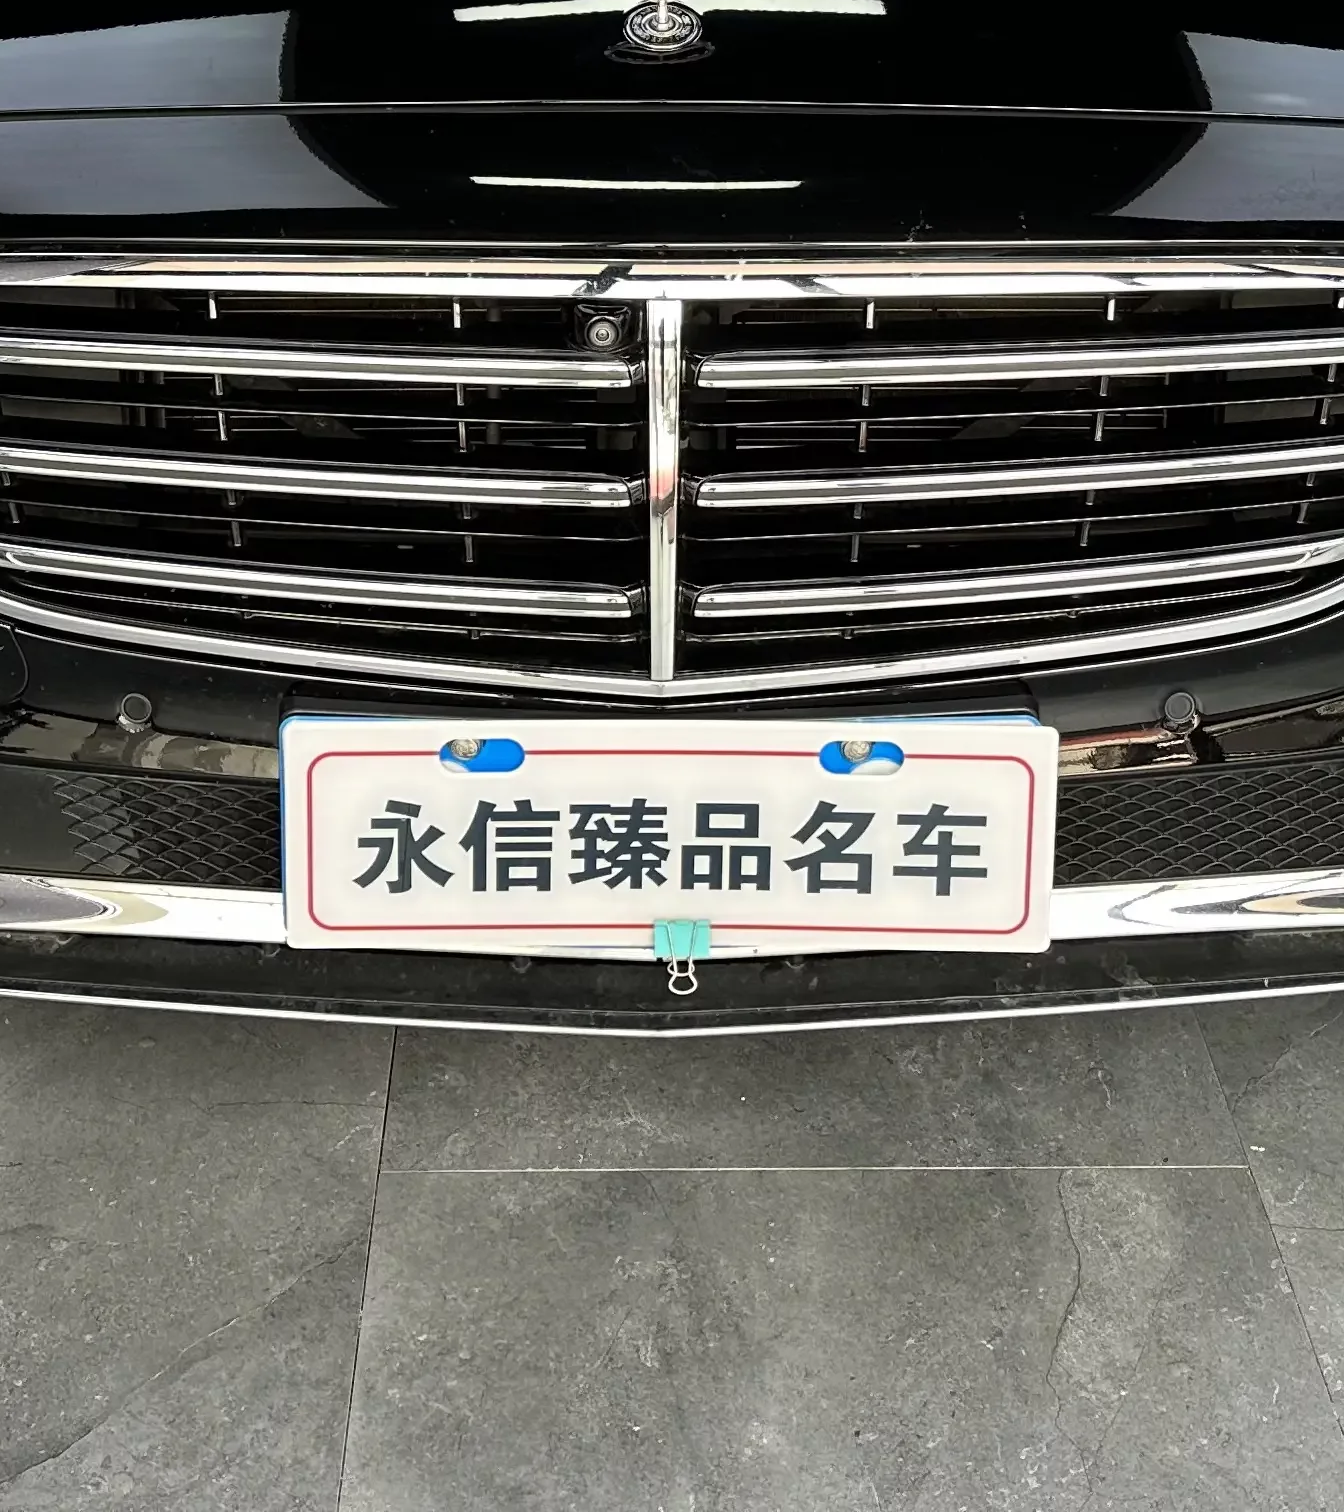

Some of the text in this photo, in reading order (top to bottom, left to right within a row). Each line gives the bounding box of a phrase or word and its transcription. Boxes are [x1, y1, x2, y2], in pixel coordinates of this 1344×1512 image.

[353, 797, 990, 898] 永信臻品名车
